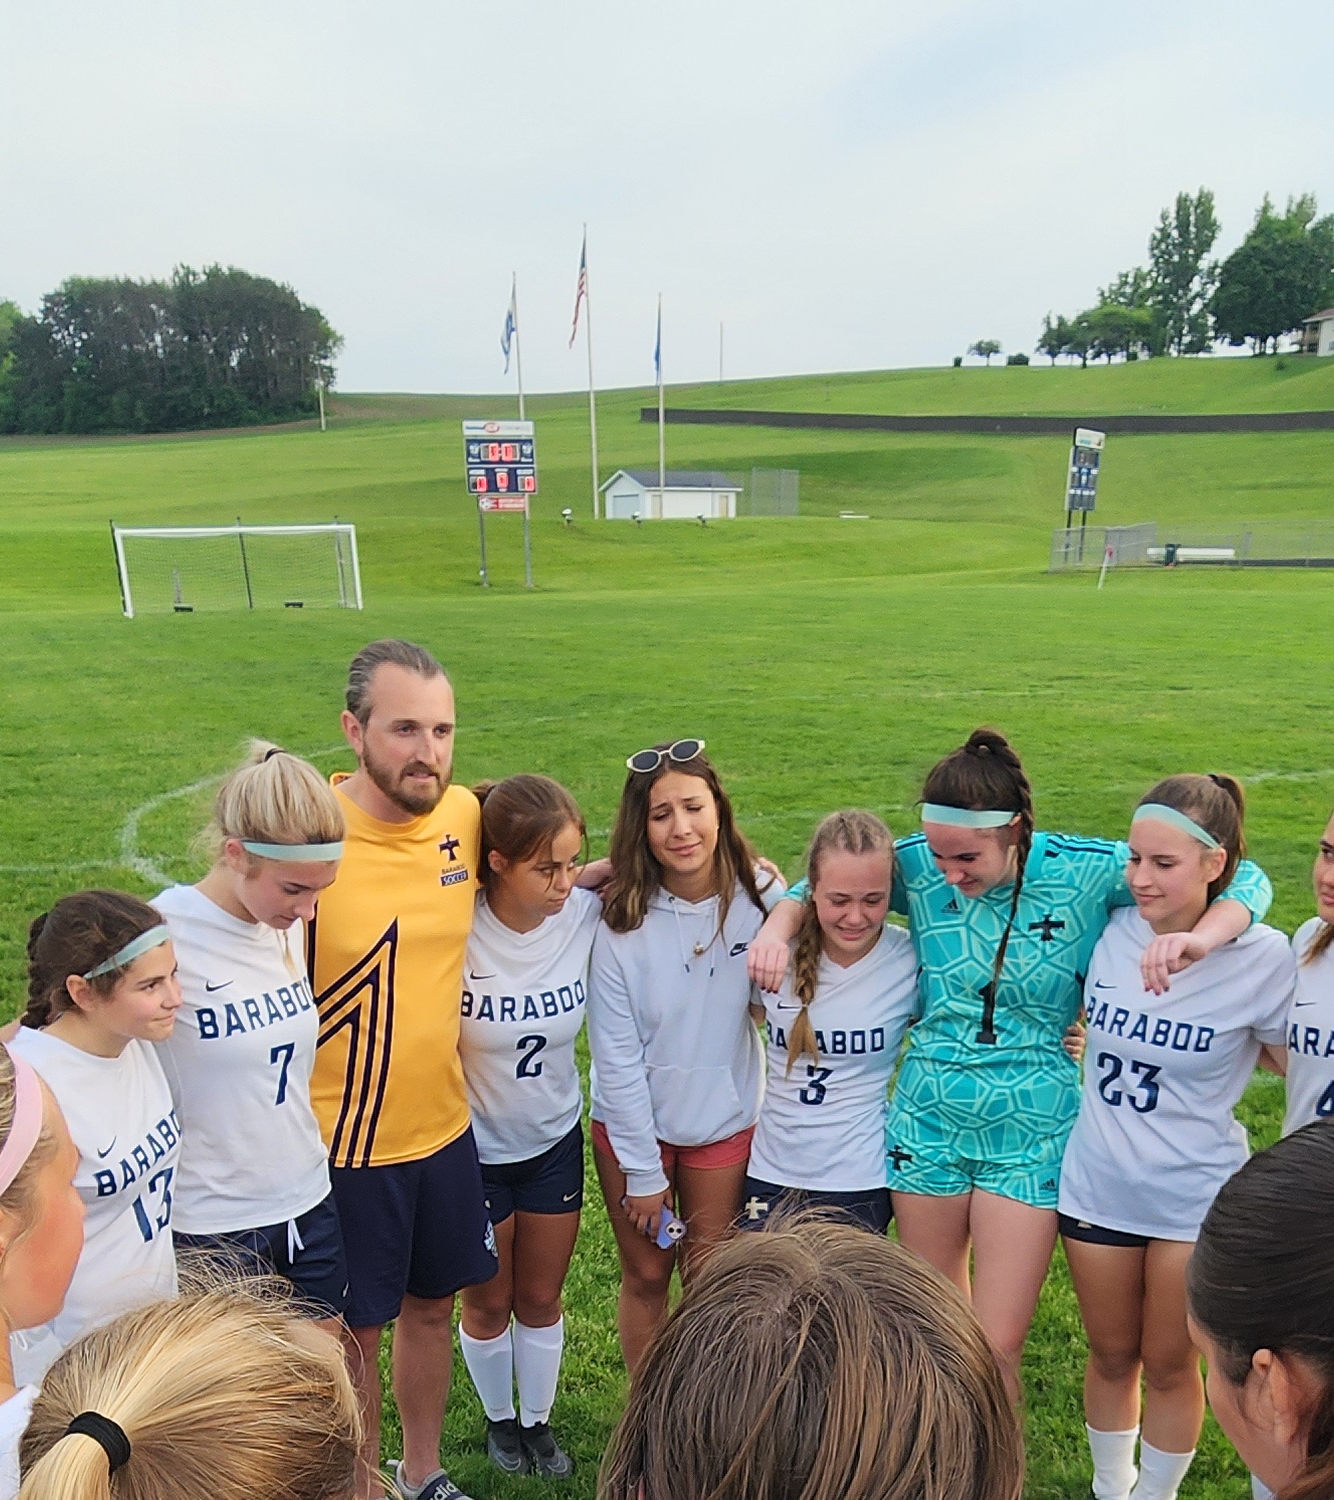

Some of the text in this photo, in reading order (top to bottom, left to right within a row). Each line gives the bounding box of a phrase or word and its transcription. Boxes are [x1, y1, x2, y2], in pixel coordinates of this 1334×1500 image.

[461, 979, 585, 1022] BARABOO
[975, 980, 998, 1046] 1
[1086, 995, 1215, 1053] BARABOO
[270, 1042, 295, 1106] 7
[516, 1034, 547, 1080] 2
[799, 1064, 834, 1106] 3
[1097, 1052, 1162, 1113] 23
[132, 1166, 174, 1243] 13
